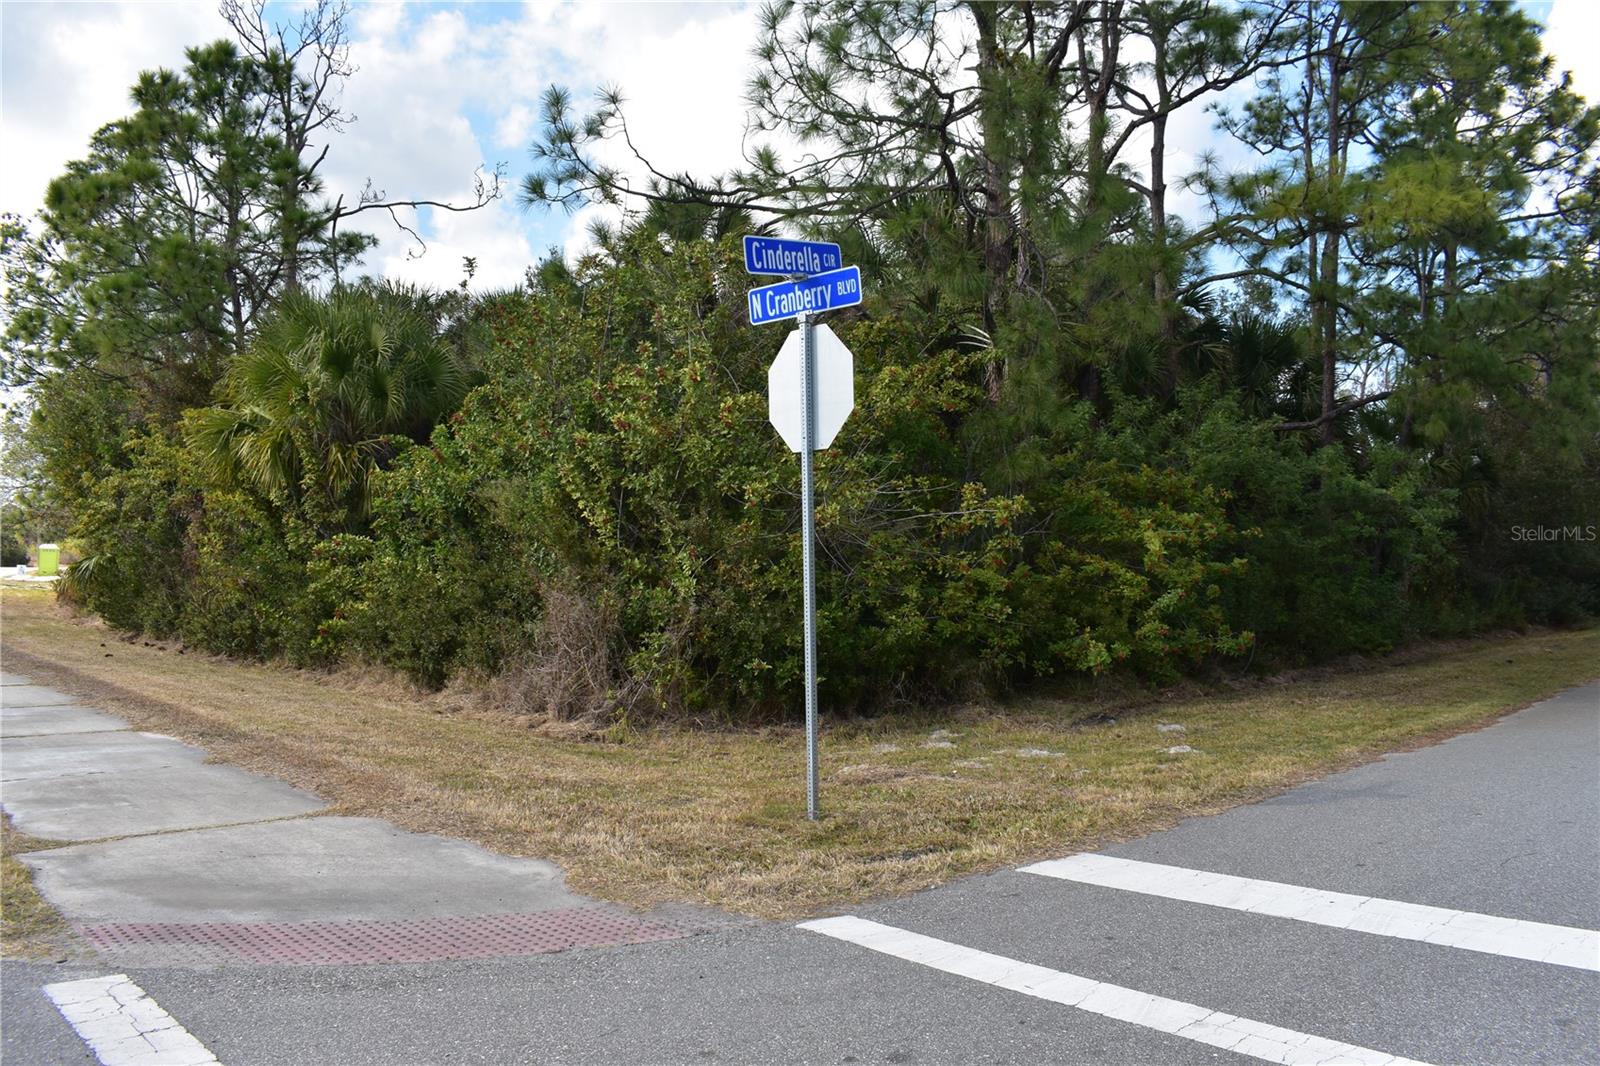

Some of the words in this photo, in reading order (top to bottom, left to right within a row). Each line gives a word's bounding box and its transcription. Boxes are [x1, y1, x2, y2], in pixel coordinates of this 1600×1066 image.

[752, 241, 820, 272] Cinderella
[823, 253, 836, 267] CIR
[752, 293, 763, 320] N
[766, 284, 831, 317] Cranberry
[837, 278, 857, 296] BLVD
